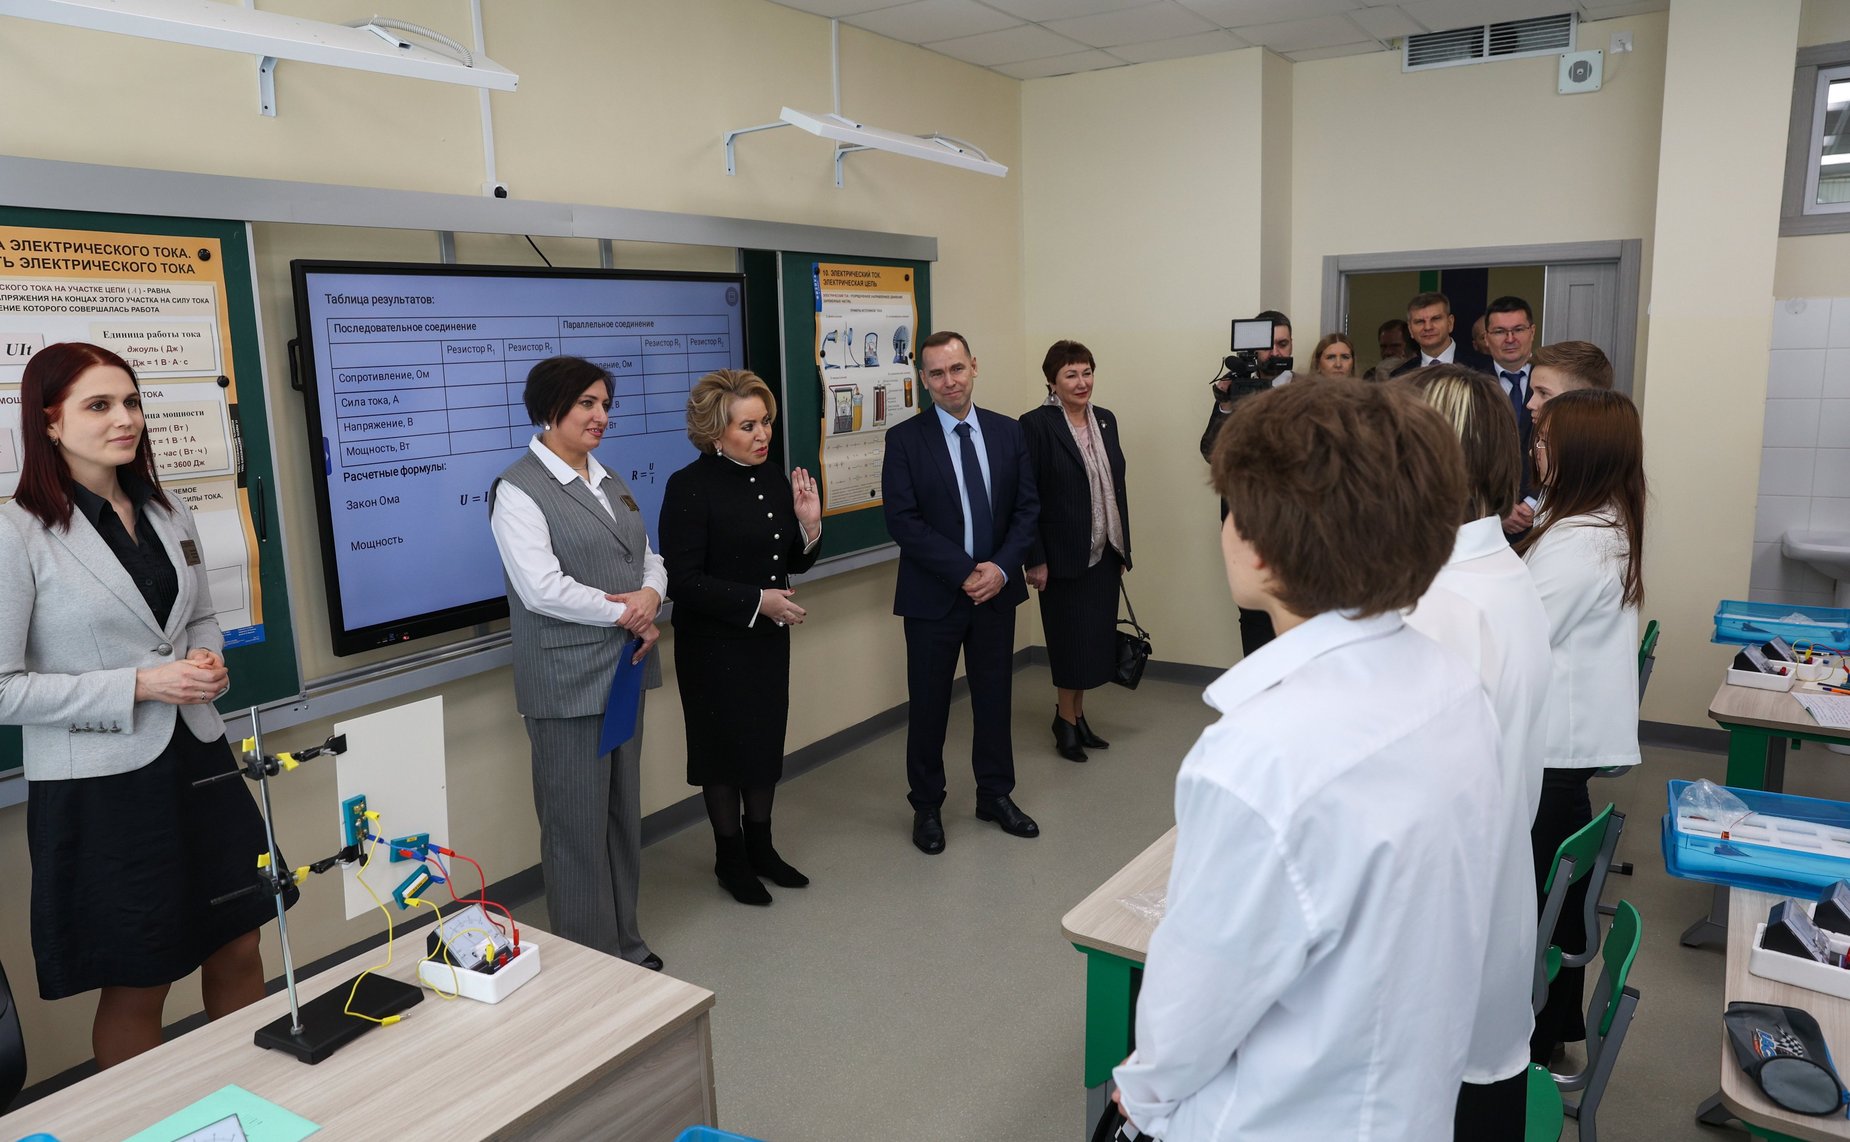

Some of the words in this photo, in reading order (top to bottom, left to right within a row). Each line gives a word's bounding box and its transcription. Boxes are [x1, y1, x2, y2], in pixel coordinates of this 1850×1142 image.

[10, 239, 150, 257] ЭЛЕКТРИЧЕСКОГО
[153, 246, 191, 258] ТОКА.
[19, 256, 157, 273] ЭЛЕКТРИЧЕСКОГО
[160, 263, 196, 274] ТОКА
[823, 279, 863, 287] ЭЛЕКТРИЧЕСКАЯ
[105, 286, 126, 295] ЦЕПИ
[0, 294, 49, 302] ПРЯЖЕНИЯ
[64, 296, 97, 304] КОНЦАХ
[324, 293, 369, 306] Таблица
[371, 294, 435, 307] результатов:
[334, 323, 423, 334] Последовательное
[424, 322, 477, 333] соединение
[563, 320, 614, 330] Параллельное
[615, 320, 654, 330] соединение
[103, 330, 144, 340] Единица
[146, 330, 179, 340] работы
[644, 339, 673, 349] Резистор
[690, 338, 716, 347] Резистор
[127, 345, 159, 354] джоуль
[447, 345, 486, 355] Резистор
[508, 343, 544, 354] Резистор
[622, 360, 633, 368] Ом
[338, 371, 414, 384] Сопротивление,
[416, 369, 430, 379] Ом
[341, 397, 366, 408] Сила
[368, 396, 391, 406] тока,
[392, 395, 400, 405] А
[163, 410, 205, 419] мощности
[343, 419, 406, 433] Напряжение,
[408, 417, 414, 427] В
[346, 444, 398, 457] Мощность,
[399, 441, 410, 451] Вт
[174, 460, 192, 469] 3600
[193, 460, 205, 468] Дж
[343, 467, 399, 482] Расчетные
[400, 462, 447, 476] формулы:
[632, 470, 638, 481] R
[346, 497, 377, 511] Закон
[379, 494, 400, 505] Ома
[460, 494, 468, 505] U
[351, 536, 404, 551] Мощность
